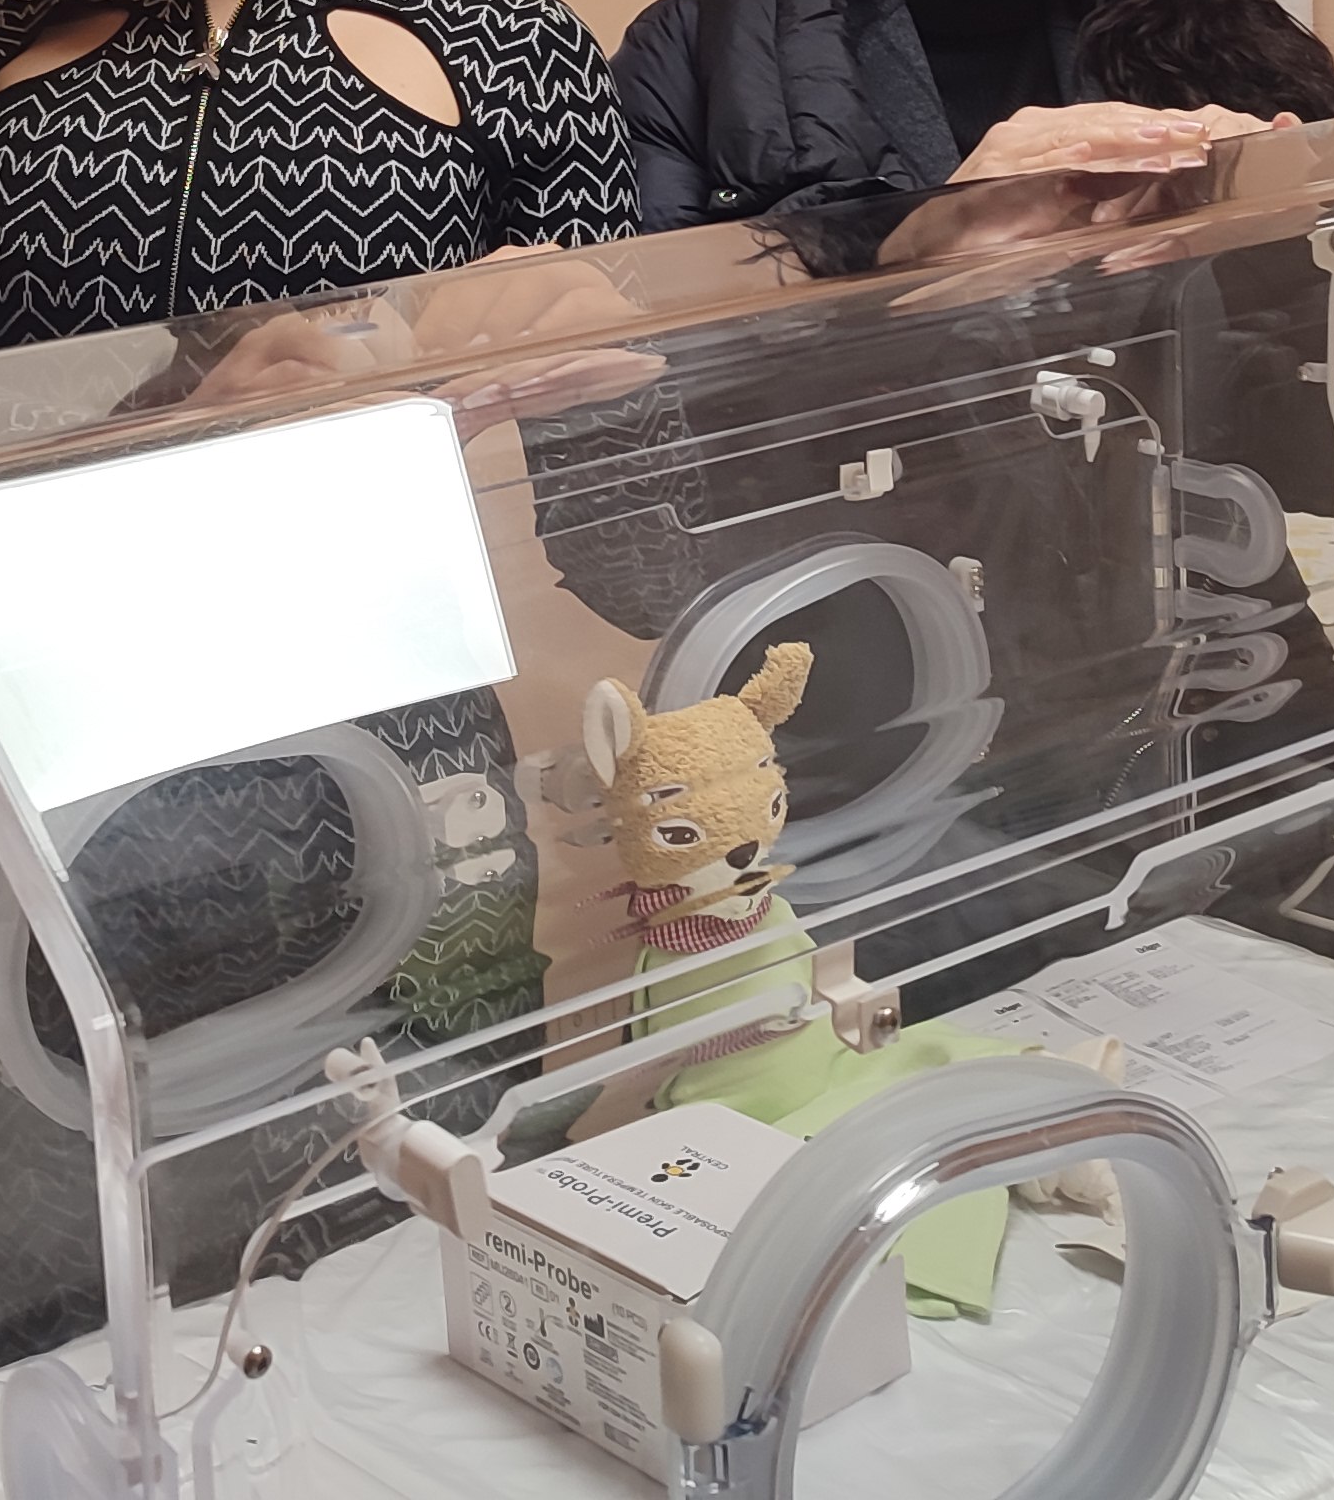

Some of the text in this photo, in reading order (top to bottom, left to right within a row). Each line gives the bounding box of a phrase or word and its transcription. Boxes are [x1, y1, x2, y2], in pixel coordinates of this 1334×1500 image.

[680, 1145, 730, 1171] CENTRAL
[546, 1168, 679, 1239] Premi-Probe
[576, 1161, 732, 1239] SPOSABLE SKIN TEMPERATURE
[485, 1231, 594, 1300] remi-Probe
